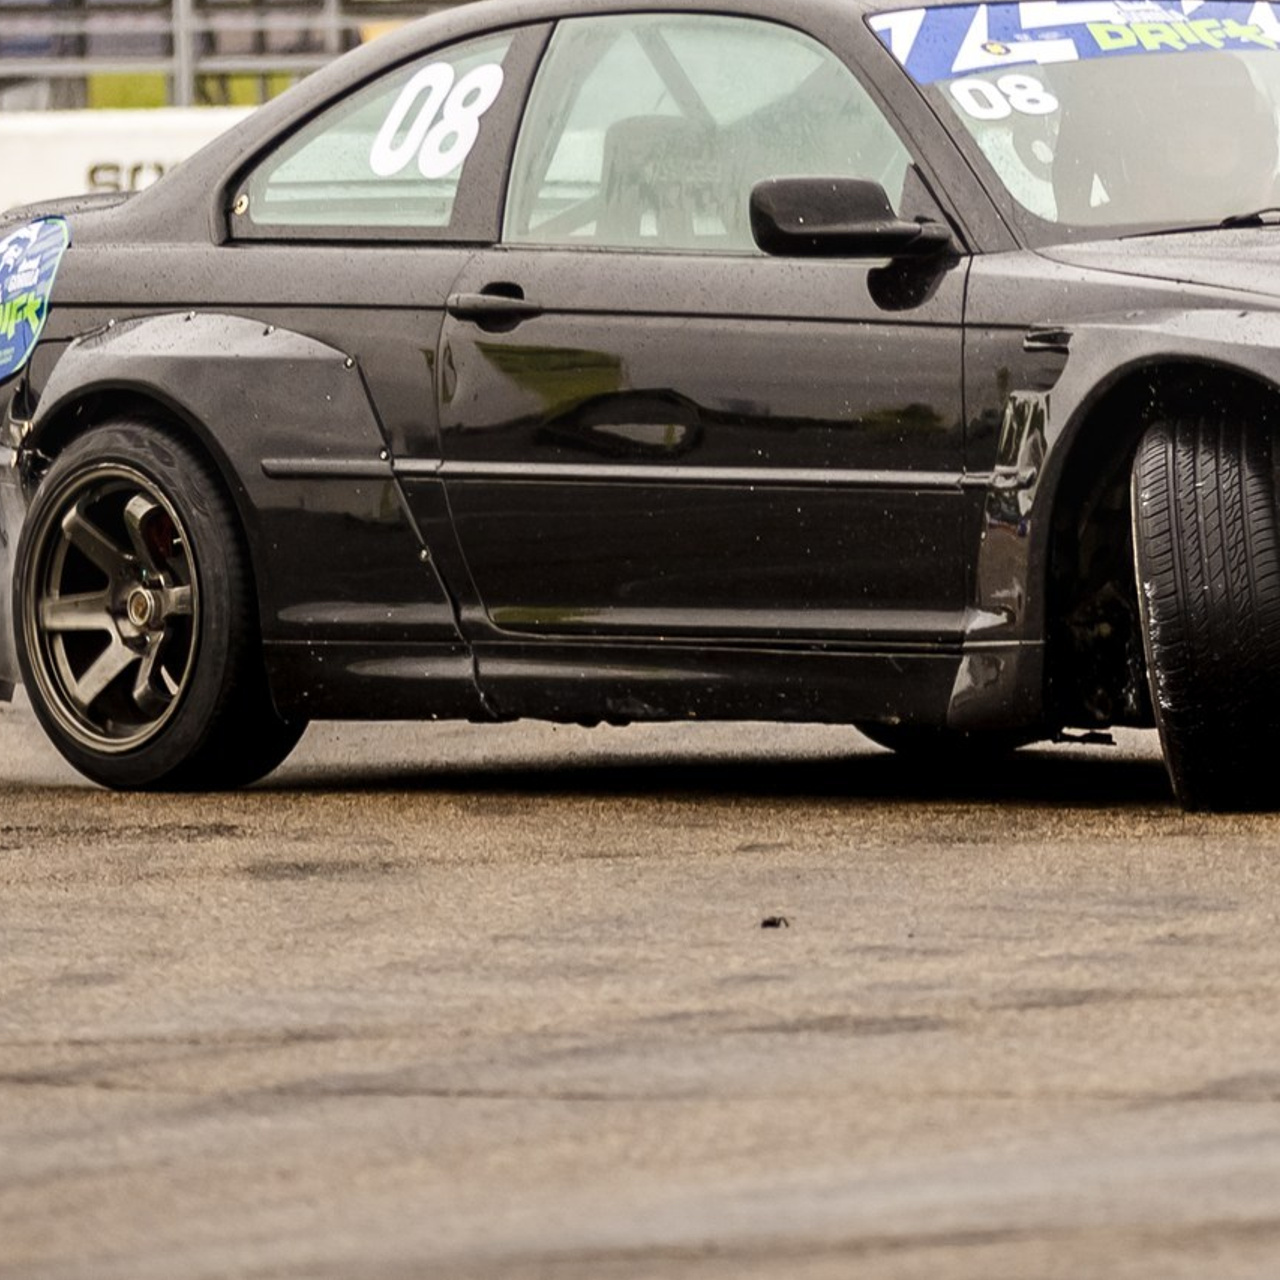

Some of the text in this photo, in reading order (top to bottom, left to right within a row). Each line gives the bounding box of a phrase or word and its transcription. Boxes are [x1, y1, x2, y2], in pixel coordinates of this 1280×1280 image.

[1086, 19, 1278, 50] DRIFT
[950, 74, 1058, 120] 08
[370, 62, 504, 179] 08
